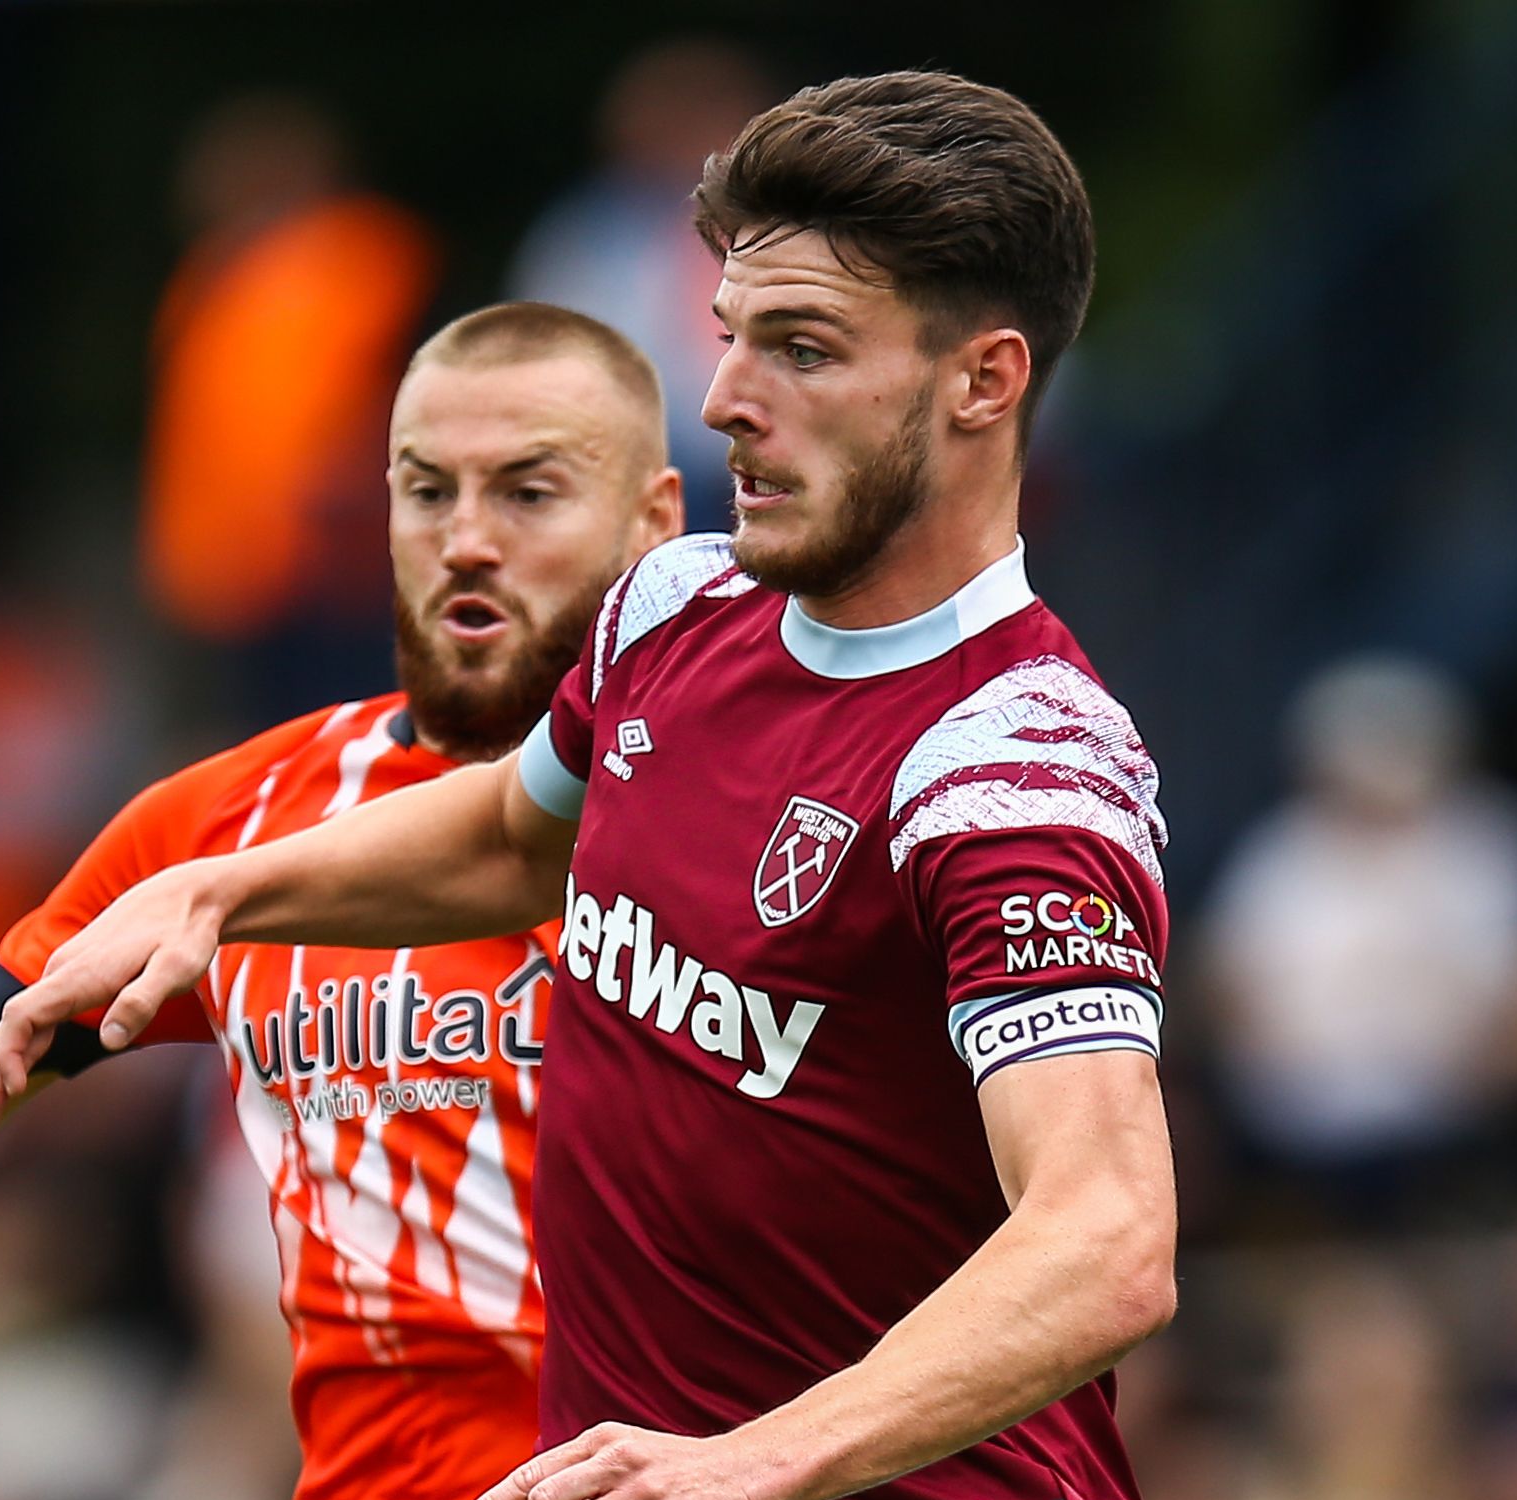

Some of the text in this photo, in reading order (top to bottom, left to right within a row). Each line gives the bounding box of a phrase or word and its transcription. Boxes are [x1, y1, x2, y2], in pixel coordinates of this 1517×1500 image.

[793, 806, 847, 841] WEST HAM
[798, 822, 831, 843] UNITED
[1006, 935, 1161, 987] MARKETS
[241, 973, 489, 1084] utilita
[974, 993, 1141, 1056] Captain
[296, 1078, 368, 1127] with
[376, 1078, 489, 1125] power
